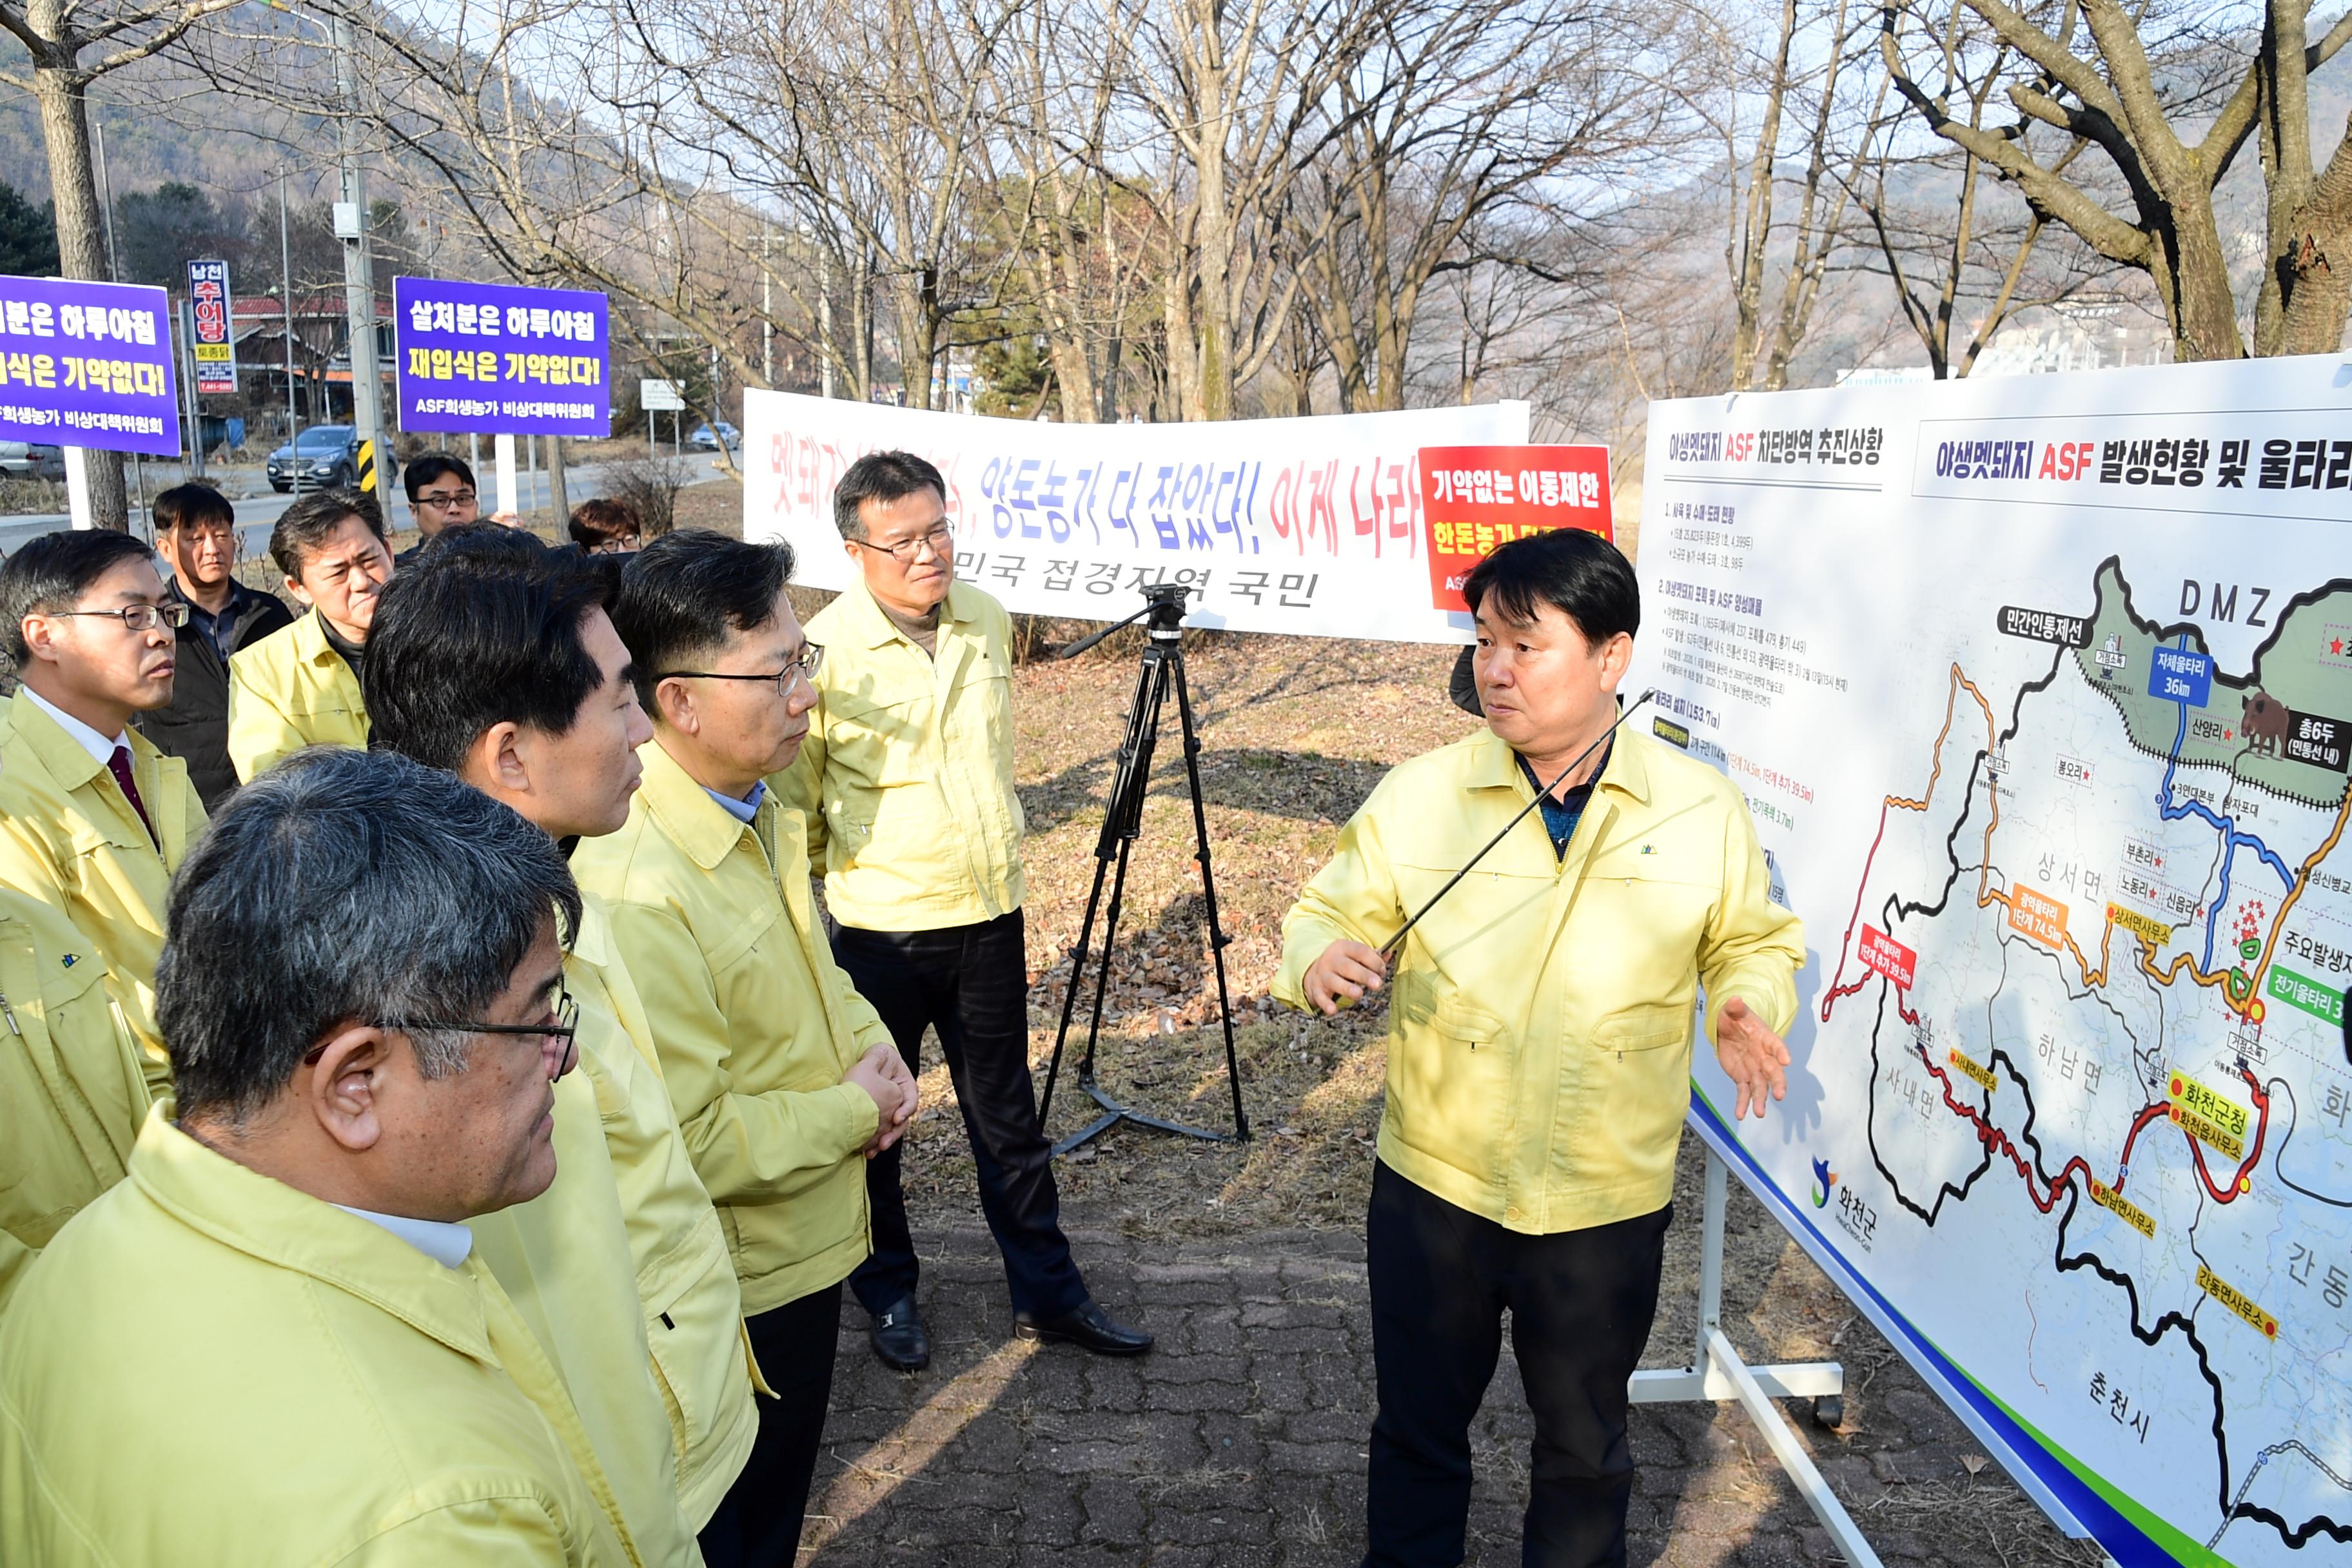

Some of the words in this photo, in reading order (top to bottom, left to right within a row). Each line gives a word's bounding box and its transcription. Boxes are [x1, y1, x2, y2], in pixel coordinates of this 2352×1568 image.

[0, 300, 54, 337] 분은
[60, 304, 156, 345] 하루아침
[194, 280, 226, 342] 추어탕
[410, 300, 500, 336] 살처분은
[507, 307, 594, 341] 하루아침
[62, 357, 166, 397] 기약없다!
[408, 348, 498, 382] 재입식은
[505, 353, 600, 386] 기약없다!
[64, 411, 163, 436] 비상대책위원회
[416, 398, 498, 416] ASF희생농가
[503, 401, 594, 419] 비상대책위원회
[1670, 431, 1721, 462] 야생멧돼지
[1725, 433, 1754, 462] ASF
[1758, 429, 1813, 465] 차단방역
[1817, 427, 1883, 466] 추진상황
[1936, 440, 2034, 479] 야생멧돼지
[2038, 442, 2094, 481] ASF
[2099, 438, 2210, 487] 발생현황
[2217, 439, 2250, 489] 및
[981, 456, 1103, 546] 양돈농가
[1107, 462, 1142, 548] 다
[1148, 461, 1262, 554] 잡았다!
[1269, 459, 1338, 556] 이게
[1432, 470, 1514, 504] 기약없는
[1518, 469, 1599, 508] 이동제한
[1685, 504, 1692, 520] 및
[1721, 506, 1735, 524] 현황
[1043, 558, 1211, 602] 접경지역
[1228, 571, 1318, 608] 국민
[1658, 579, 1665, 593] 2.
[1665, 580, 1694, 601] 야생멧돼지
[1695, 585, 1708, 605] 포획
[1709, 589, 1716, 607] 및
[1717, 591, 1734, 609] ASF
[2179, 579, 2270, 627] DMZ
[2007, 609, 2082, 645] 민간인통제선
[2157, 652, 2205, 677] 자체울타리
[2192, 718, 2222, 741] 산양리
[2298, 718, 2335, 744] 총6두
[2058, 760, 2082, 781] 봉오리
[2288, 738, 2322, 761] (민통선
[2324, 747, 2340, 766] 내)
[2177, 783, 2215, 805] 3연대본부
[2126, 843, 2154, 867] 부촌리
[2038, 852, 2101, 904] 상서면
[2121, 874, 2149, 899] 노동리
[2012, 908, 2034, 931] 1단계
[2021, 892, 2058, 923] 광역울타리
[2115, 908, 2170, 944] 상서면사무소
[1861, 944, 1877, 965] 1단계
[1876, 953, 1890, 973] 추가
[2275, 974, 2332, 1015] 전기울타리
[1956, 1055, 1997, 1091] 사내면사무소
[2039, 1034, 2102, 1095] 하남면
[1886, 1067, 1934, 1119] 사내면
[2184, 1084, 2246, 1135] 화천군청
[2179, 1111, 2241, 1160] 화천읍사무소
[1839, 1186, 1876, 1241] 화천군
[2101, 1188, 2154, 1238] 하남면사무소
[2200, 1269, 2263, 1329] 간동면사무소
[2090, 1371, 2150, 1444] 춘천시
